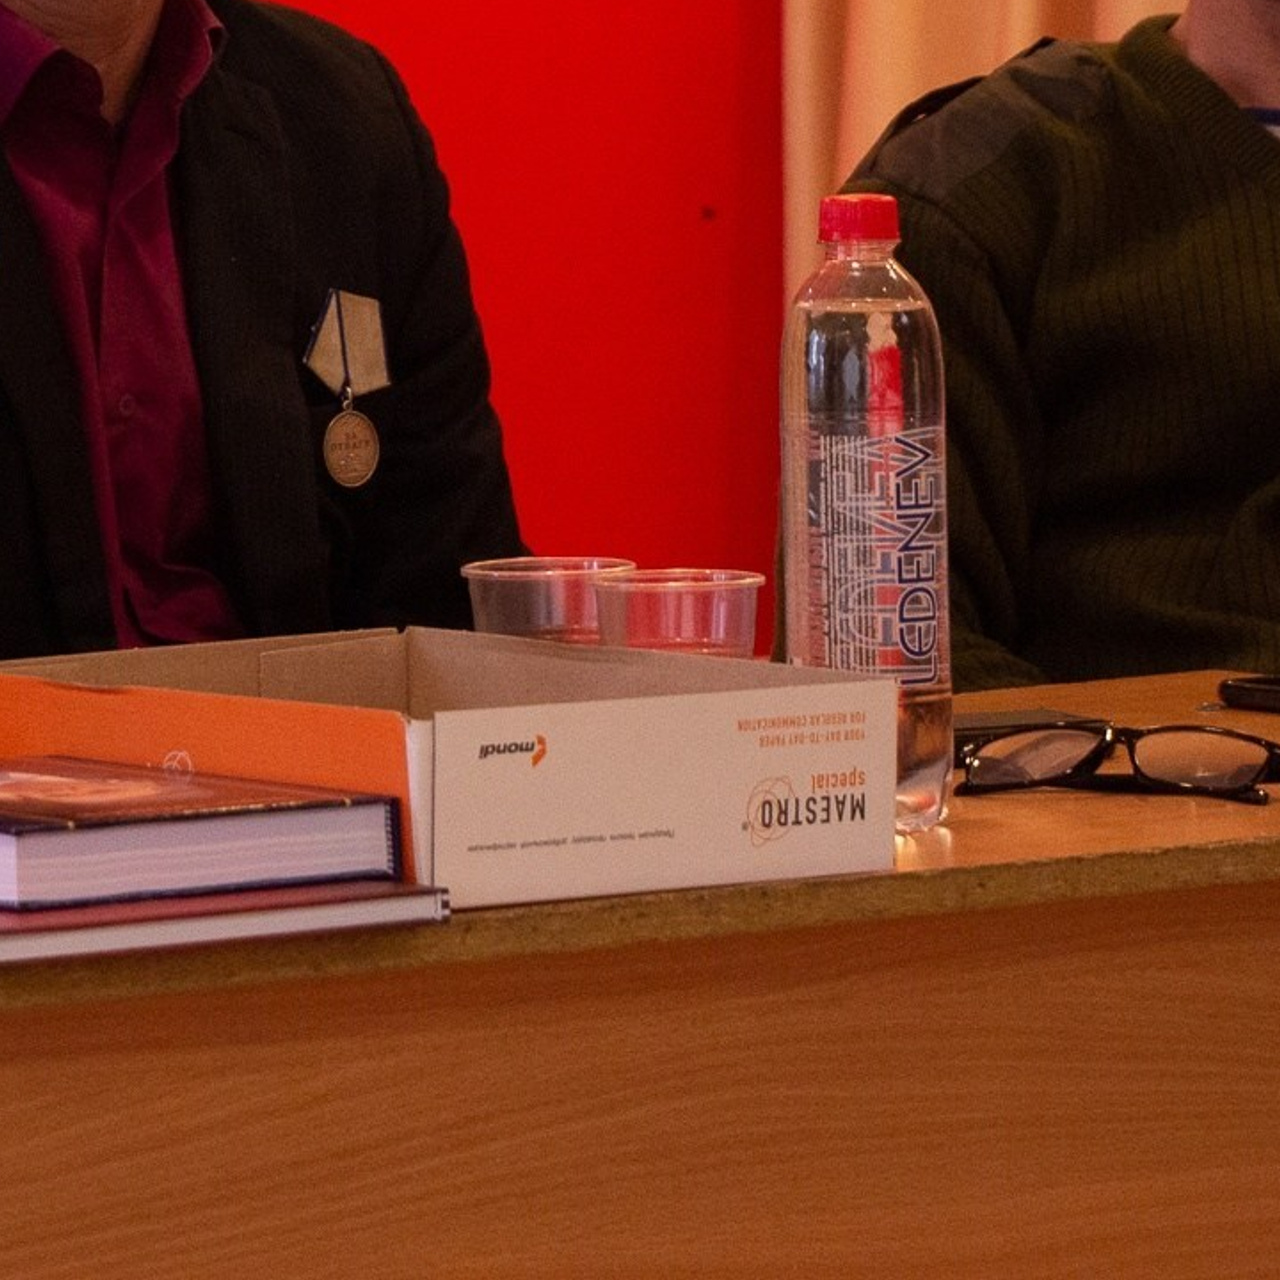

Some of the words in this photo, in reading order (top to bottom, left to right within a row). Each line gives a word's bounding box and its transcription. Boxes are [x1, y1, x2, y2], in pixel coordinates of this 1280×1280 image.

[893, 434, 938, 685] LEDENEV
[478, 739, 536, 760] mondi
[810, 768, 866, 792] special
[760, 793, 866, 829] MAESTRO
